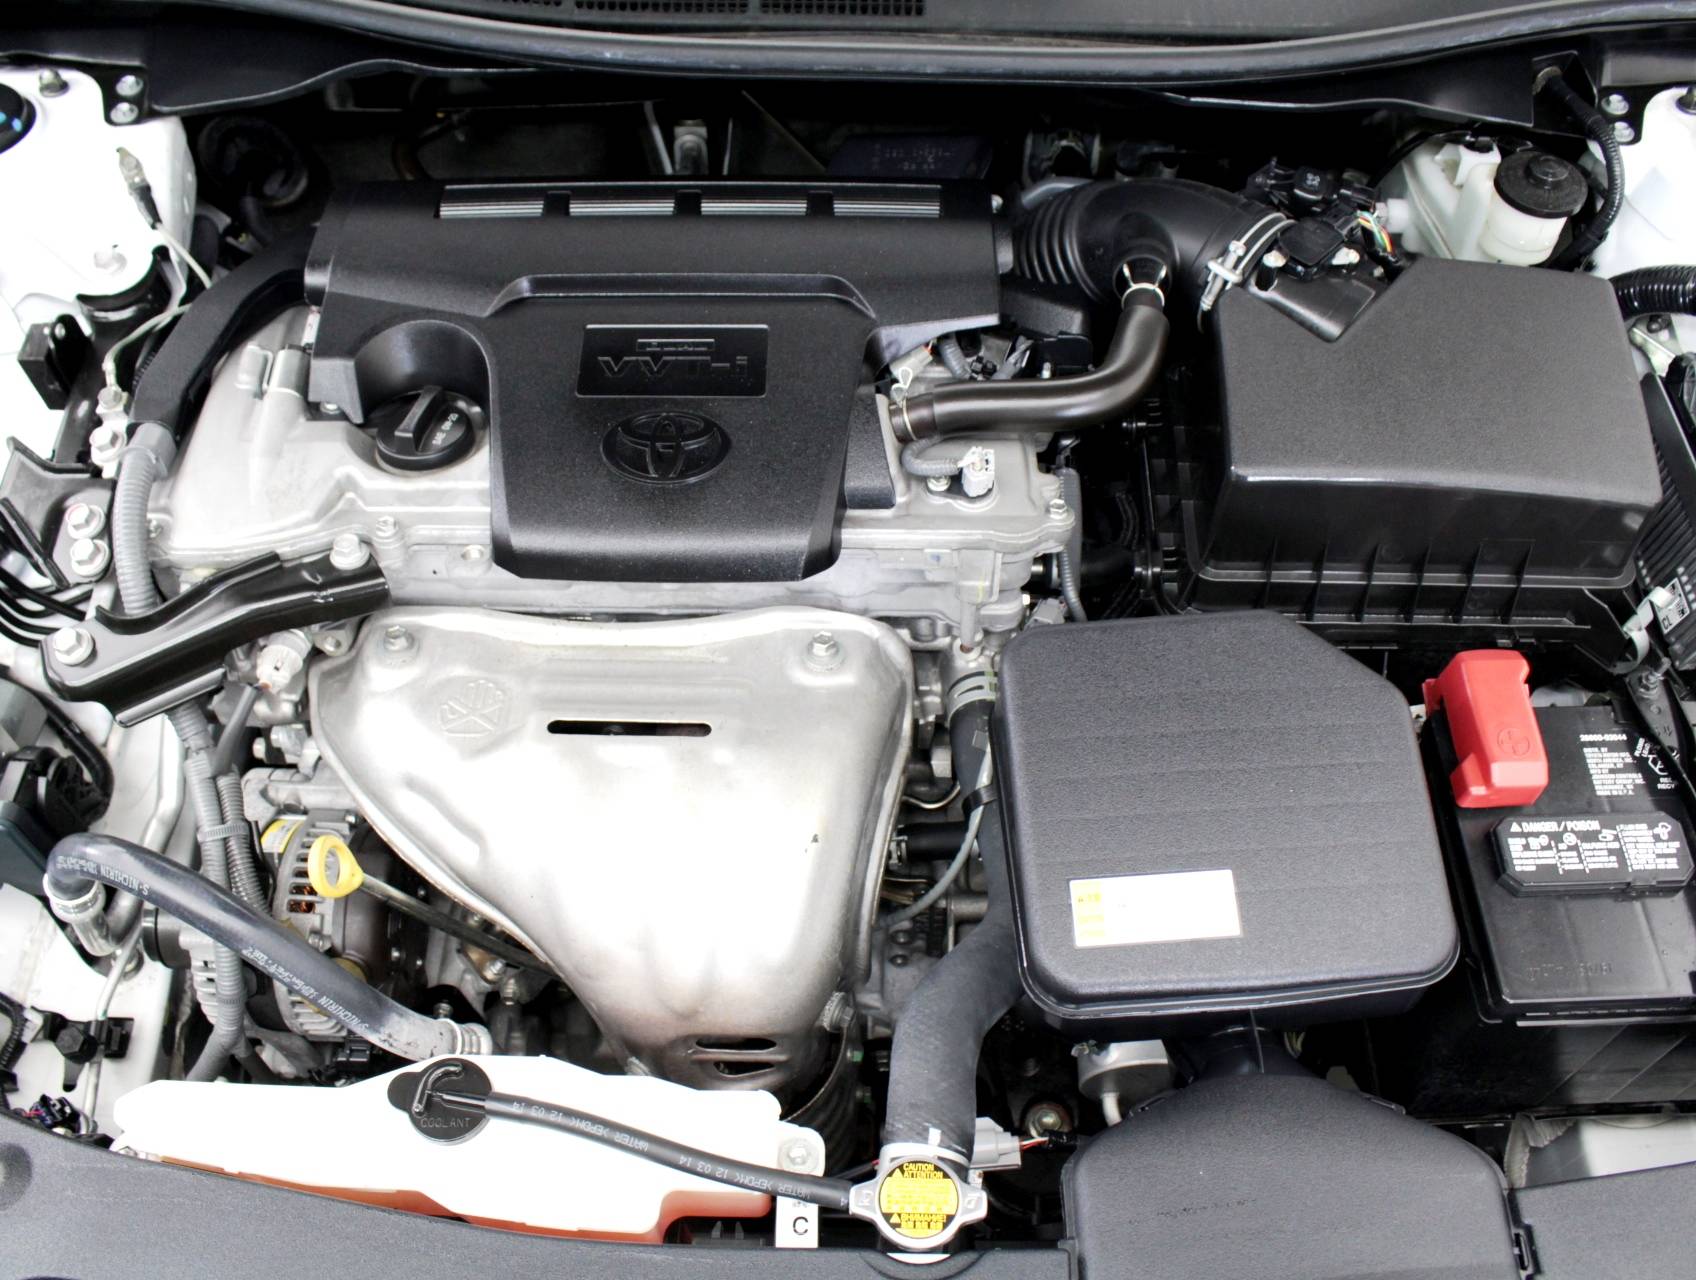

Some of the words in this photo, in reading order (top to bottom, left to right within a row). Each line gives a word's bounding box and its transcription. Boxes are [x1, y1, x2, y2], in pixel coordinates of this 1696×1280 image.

[1521, 821, 1559, 832] DANGER
[1566, 820, 1601, 831] POISON
[421, 1118, 470, 1129] COOLANT
[680, 1155, 692, 1167] 14
[903, 1163, 934, 1171] CAUTION
[715, 1167, 728, 1180] 12
[903, 1171, 944, 1179] ATTENTION
[792, 1216, 809, 1235] C
